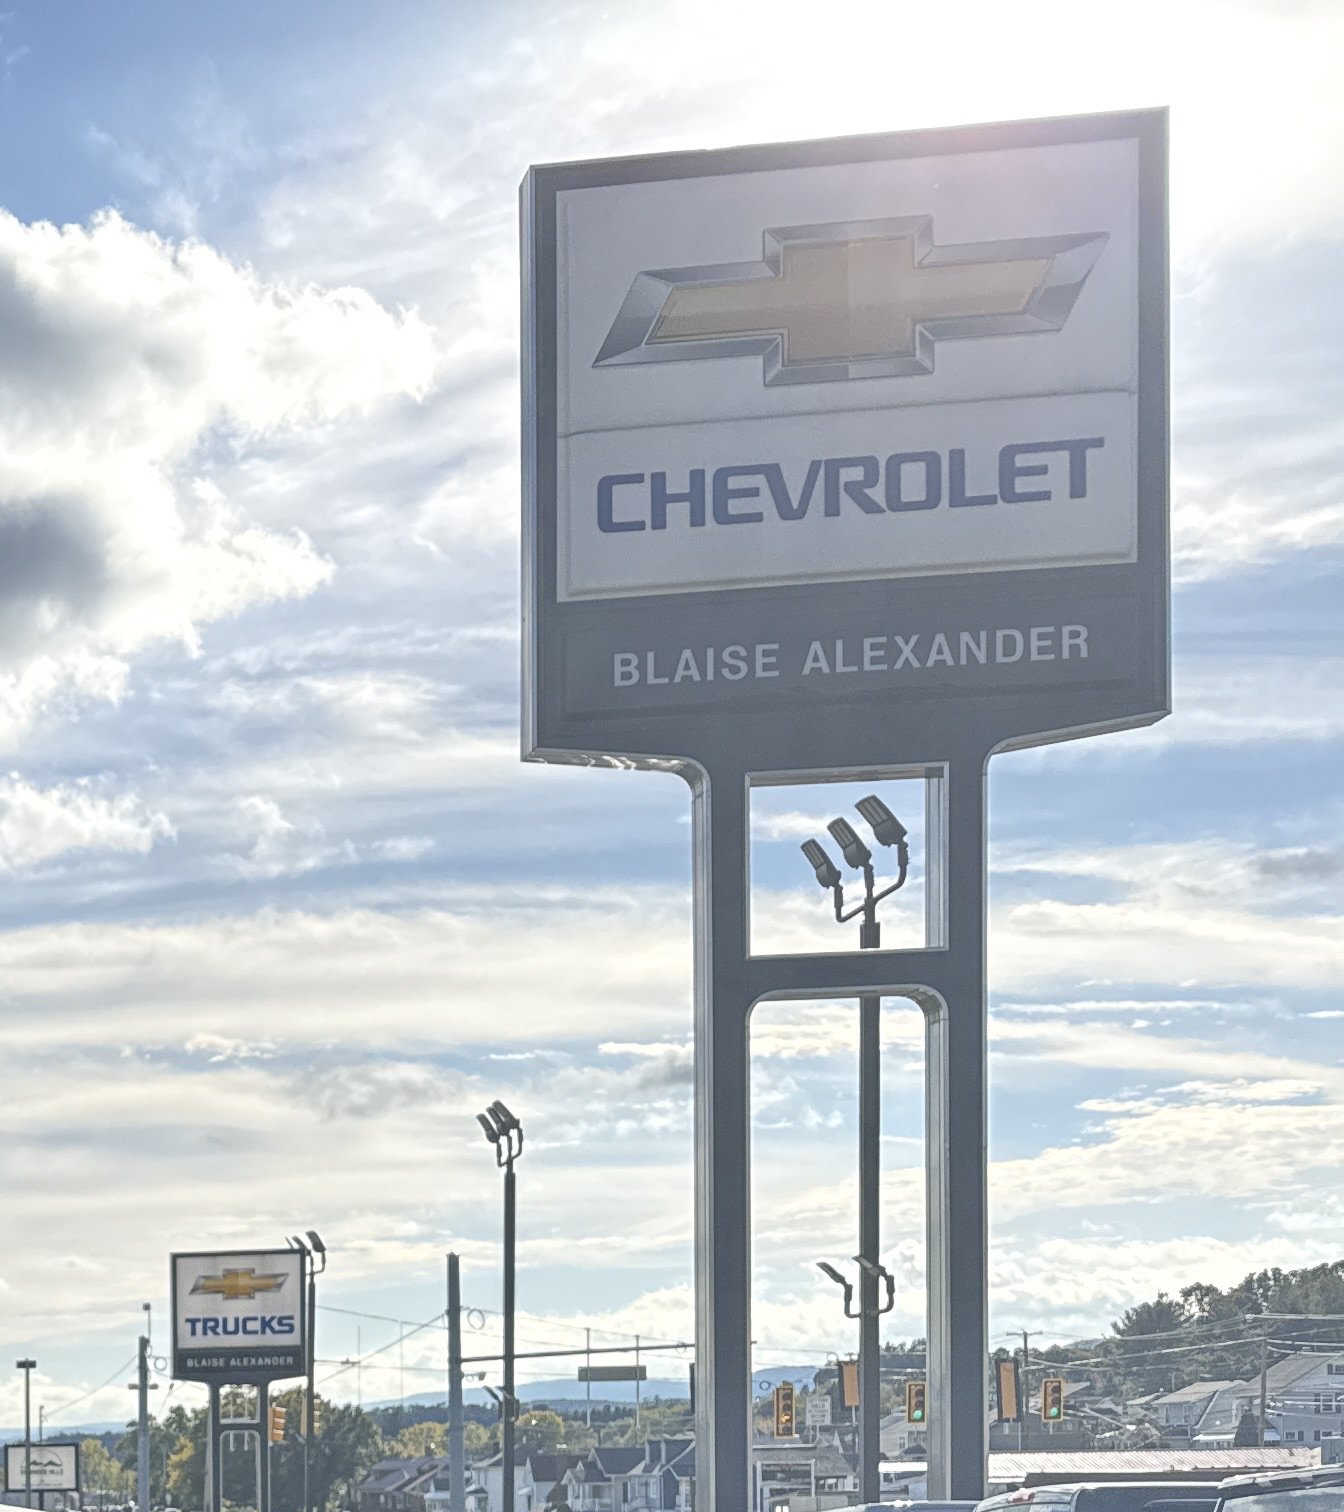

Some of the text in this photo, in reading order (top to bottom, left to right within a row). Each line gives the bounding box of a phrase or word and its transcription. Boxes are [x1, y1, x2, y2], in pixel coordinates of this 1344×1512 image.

[597, 436, 1105, 533] CHEVROLET
[612, 624, 1089, 688] BLAISE ALEXANDER
[185, 1315, 295, 1336] TRUCKS
[186, 1355, 293, 1368] BLAISE ALEXANDER
